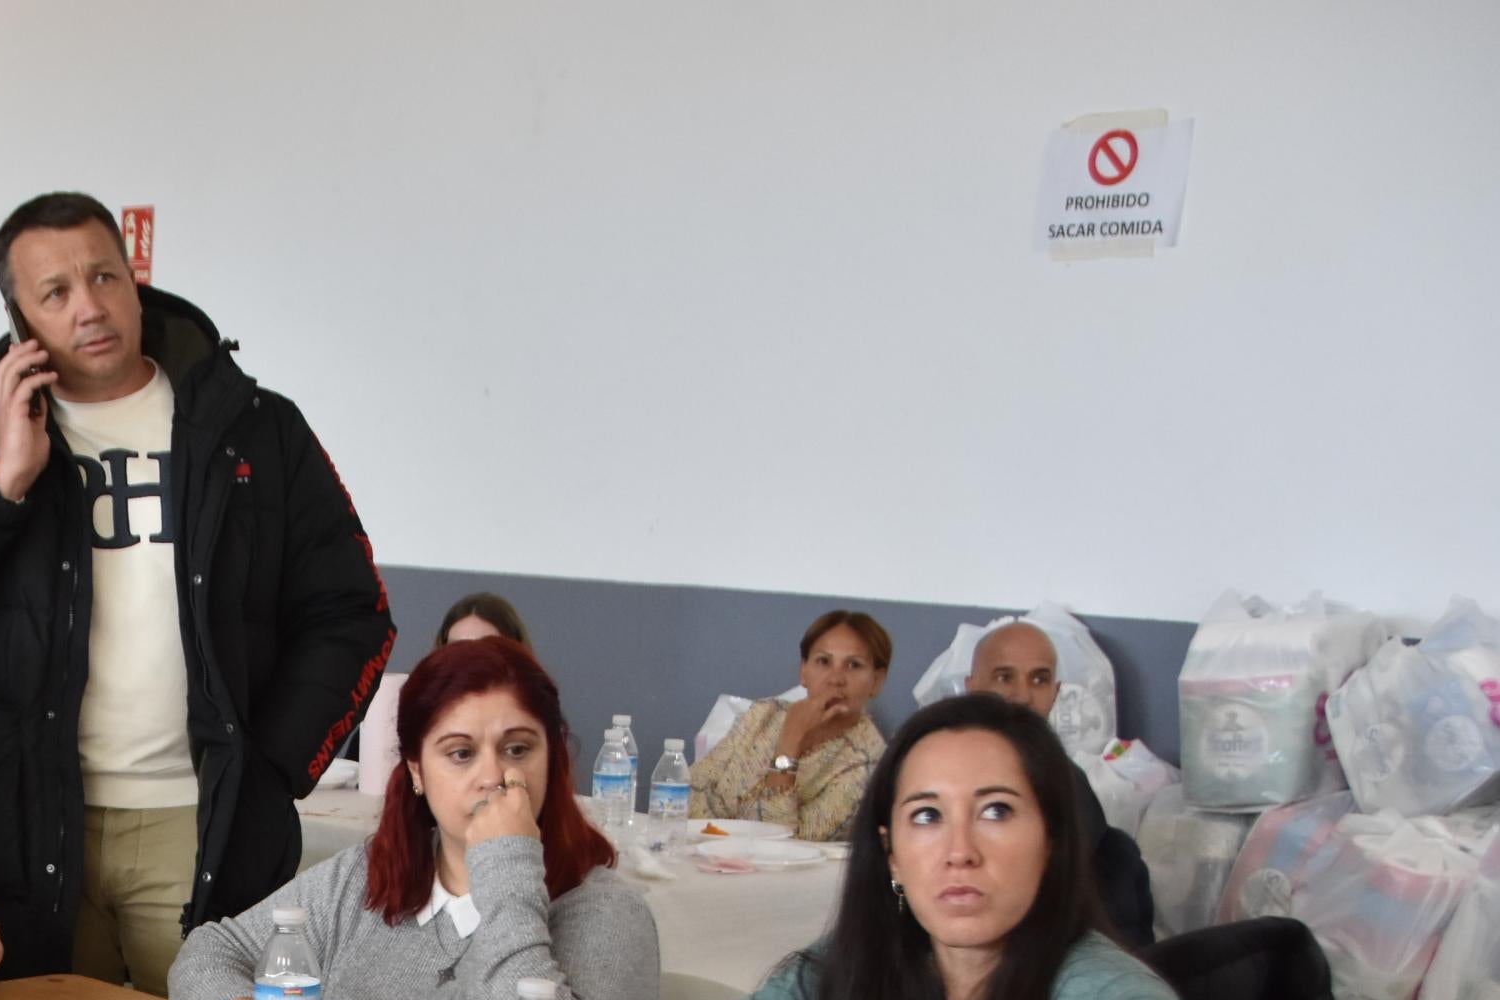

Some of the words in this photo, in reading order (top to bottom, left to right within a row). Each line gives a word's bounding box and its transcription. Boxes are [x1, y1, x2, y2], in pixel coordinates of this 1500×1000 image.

[1065, 192, 1150, 211] PROHIBIDO
[1047, 222, 1096, 239] SACAR
[1099, 219, 1164, 237] COMIDA
